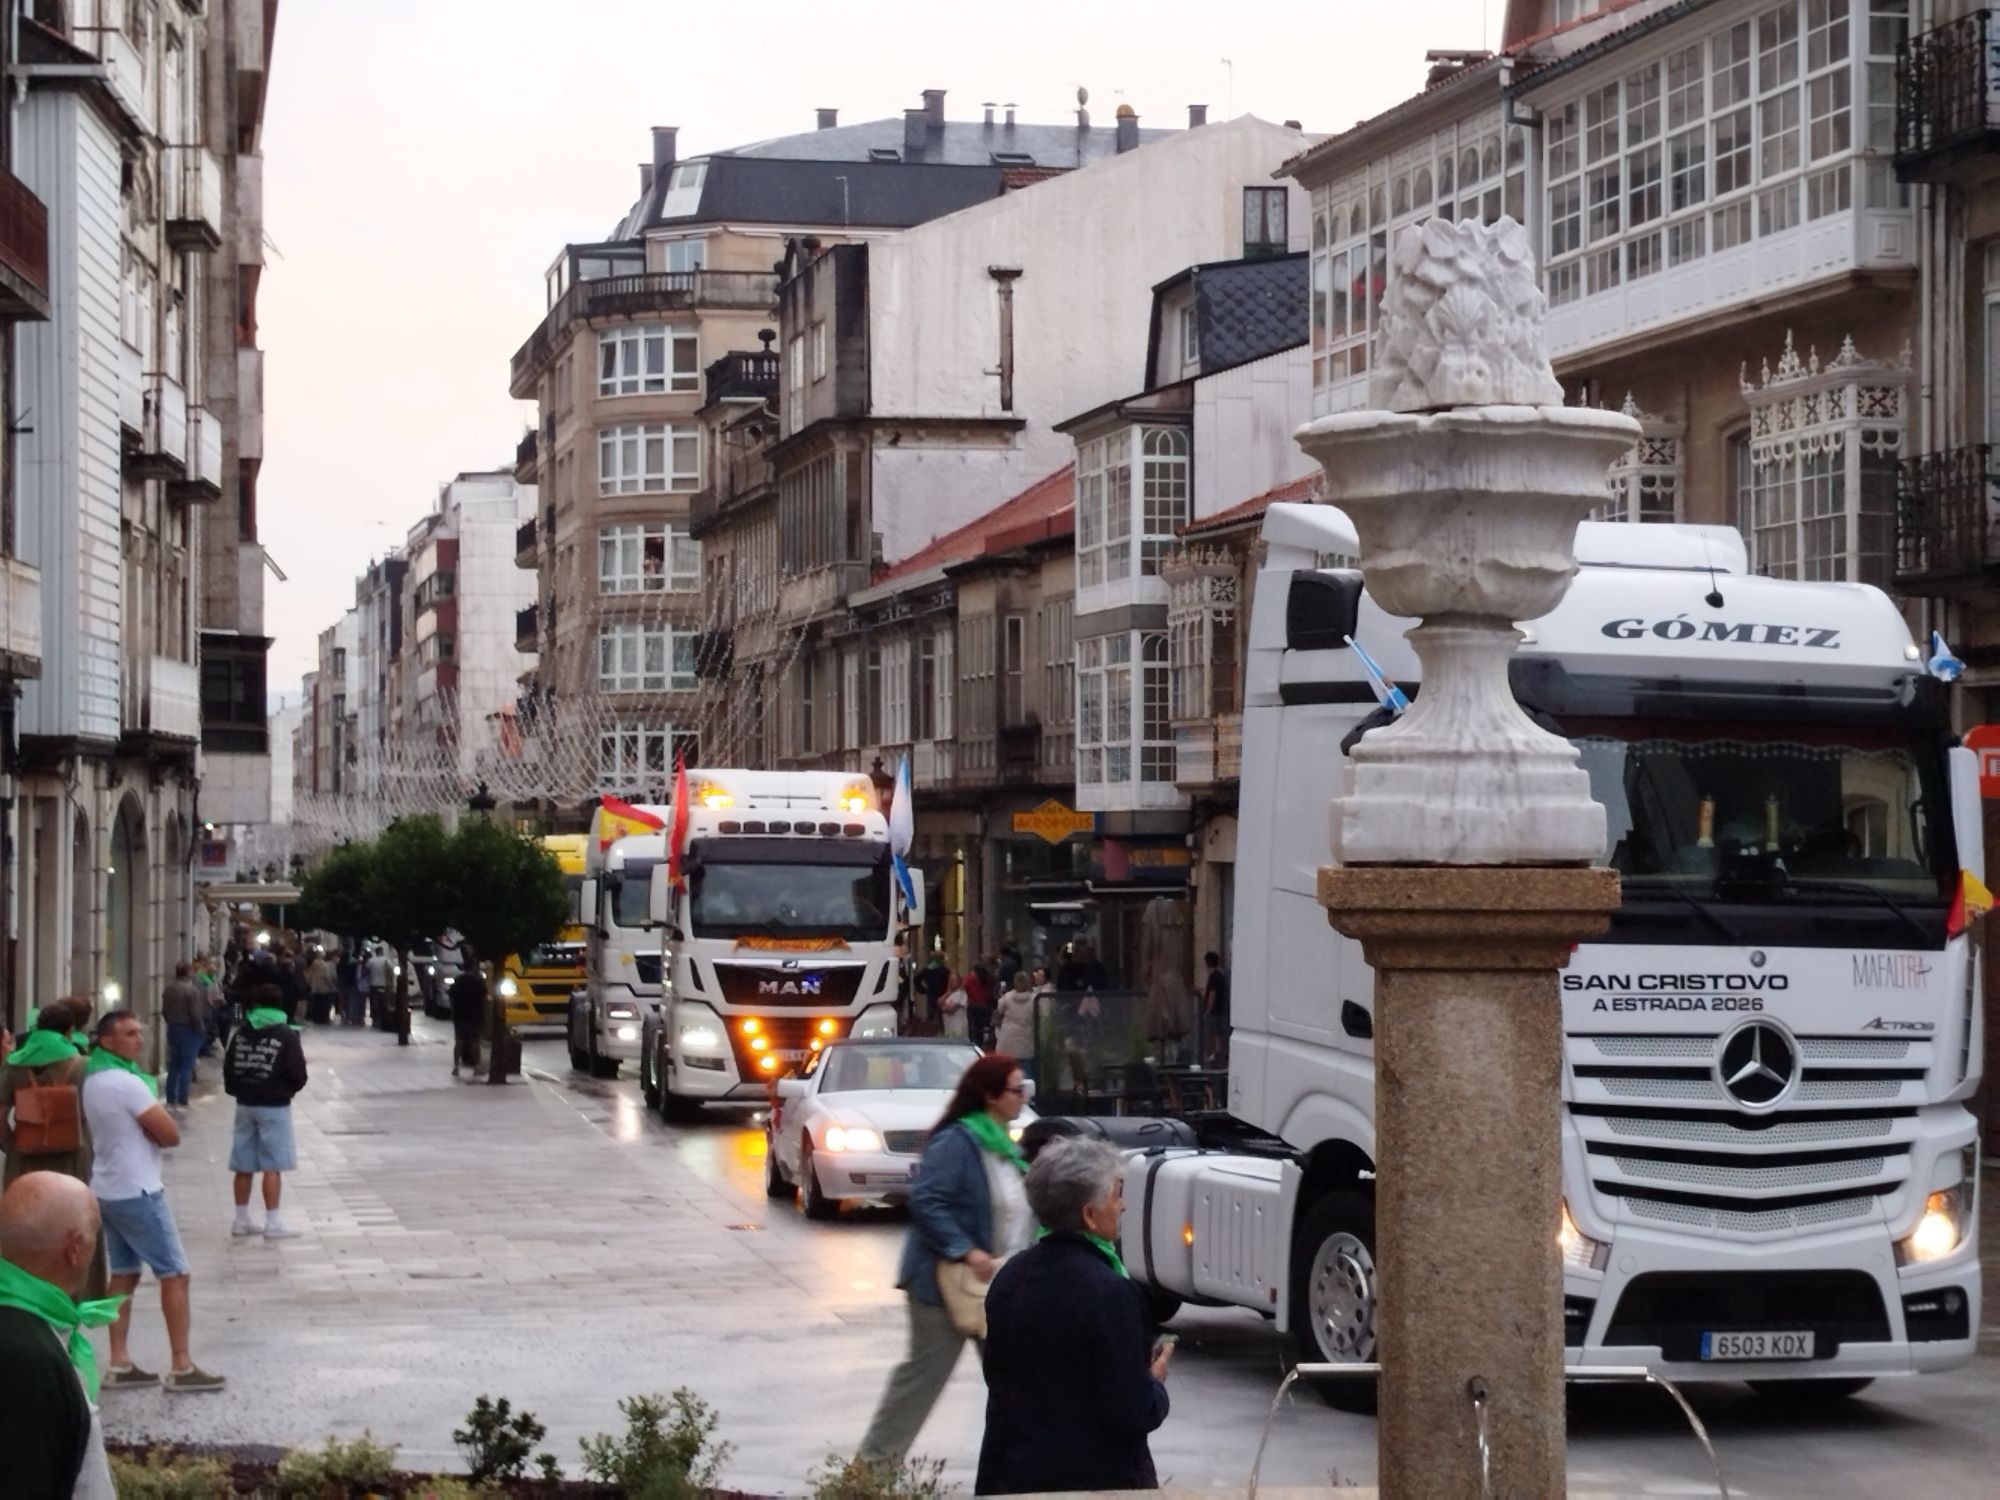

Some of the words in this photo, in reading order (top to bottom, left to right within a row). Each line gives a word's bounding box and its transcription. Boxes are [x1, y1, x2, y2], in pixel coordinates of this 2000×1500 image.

[1600, 613, 1841, 649] GÓMEZ
[759, 980, 821, 995] MAN
[1563, 975, 1631, 990] SAN
[1637, 975, 1789, 990] CRISTOVO
[1593, 998, 1608, 1011] A
[1612, 998, 1707, 1011] ESTRADA
[1711, 998, 1764, 1011] 2026
[1718, 1336, 1765, 1356] 6503
[1771, 1335, 1807, 1355] KDX
